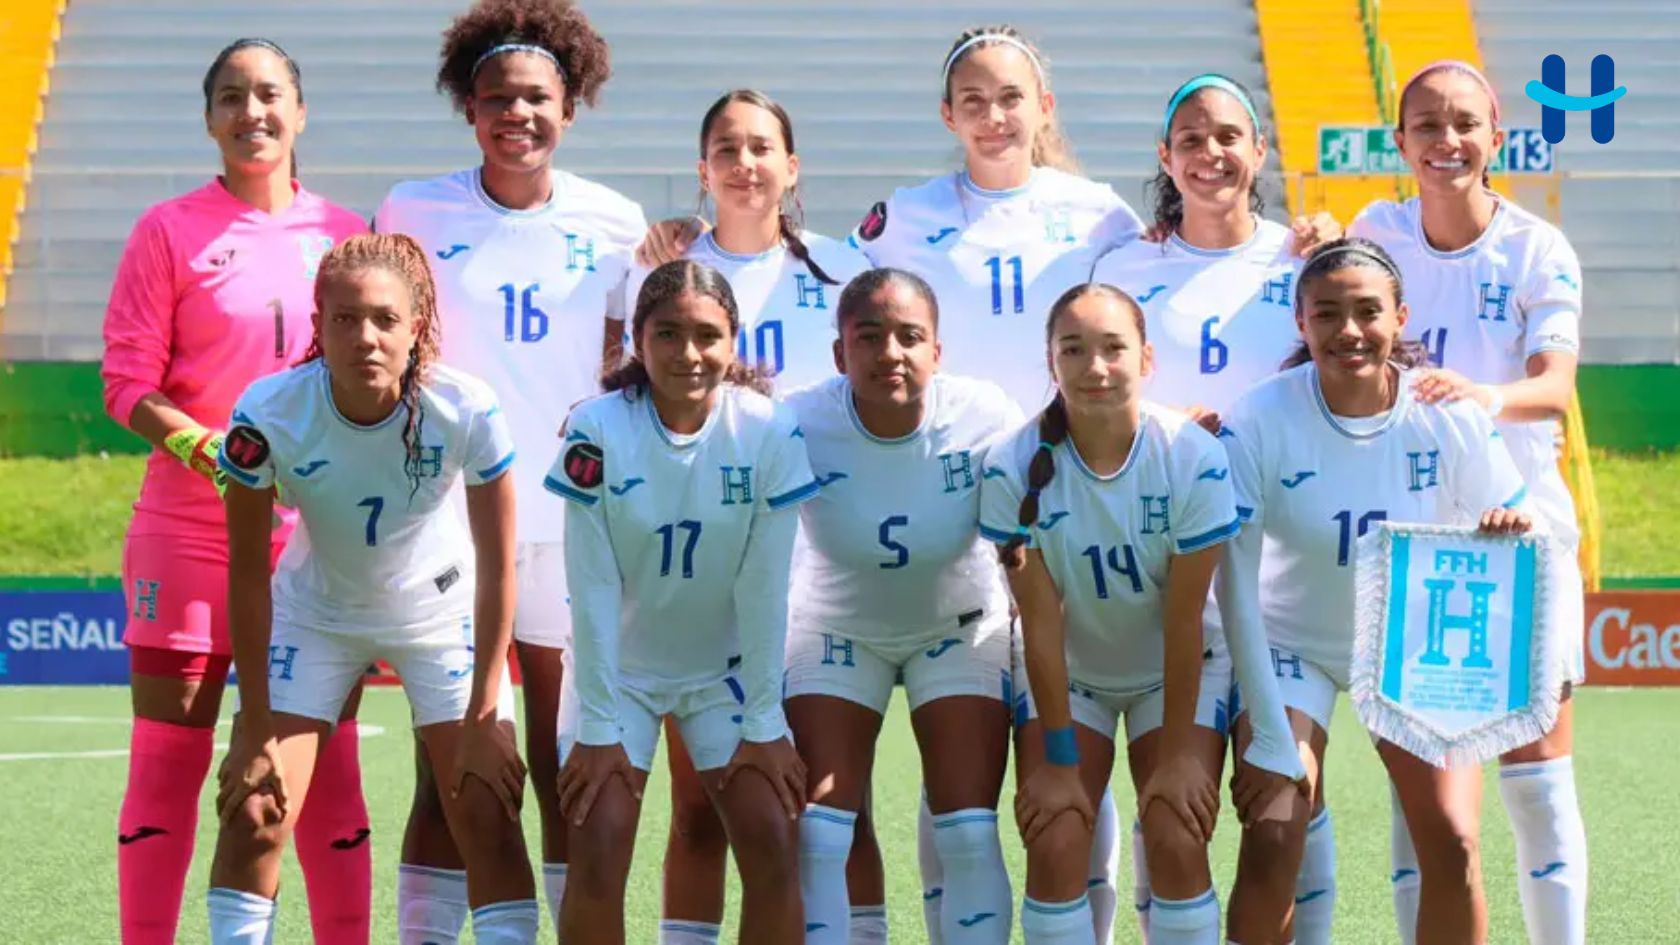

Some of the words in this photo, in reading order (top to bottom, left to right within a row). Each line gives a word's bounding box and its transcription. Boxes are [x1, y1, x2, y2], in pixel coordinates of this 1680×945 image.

[1513, 132, 1551, 170] 13
[565, 233, 596, 272] H
[794, 273, 827, 310] H
[983, 255, 1024, 315] 11
[1261, 271, 1293, 307] H
[1477, 282, 1513, 321] H
[266, 298, 284, 358] 1
[497, 282, 549, 343] 16
[1200, 316, 1228, 374] 6
[720, 465, 753, 505] H
[938, 449, 975, 493] H
[1406, 449, 1439, 491] H
[357, 496, 385, 547] 7
[1139, 495, 1171, 535] H
[654, 519, 702, 579] 17
[878, 515, 909, 569] 5
[1435, 548, 1488, 575] FFH
[1081, 543, 1144, 599] 14
[133, 577, 162, 622] H
[6, 611, 128, 651] SEÑAL
[1418, 578, 1498, 668] H
[268, 645, 300, 682] H
[821, 632, 856, 668] H
[1269, 646, 1304, 681] H
